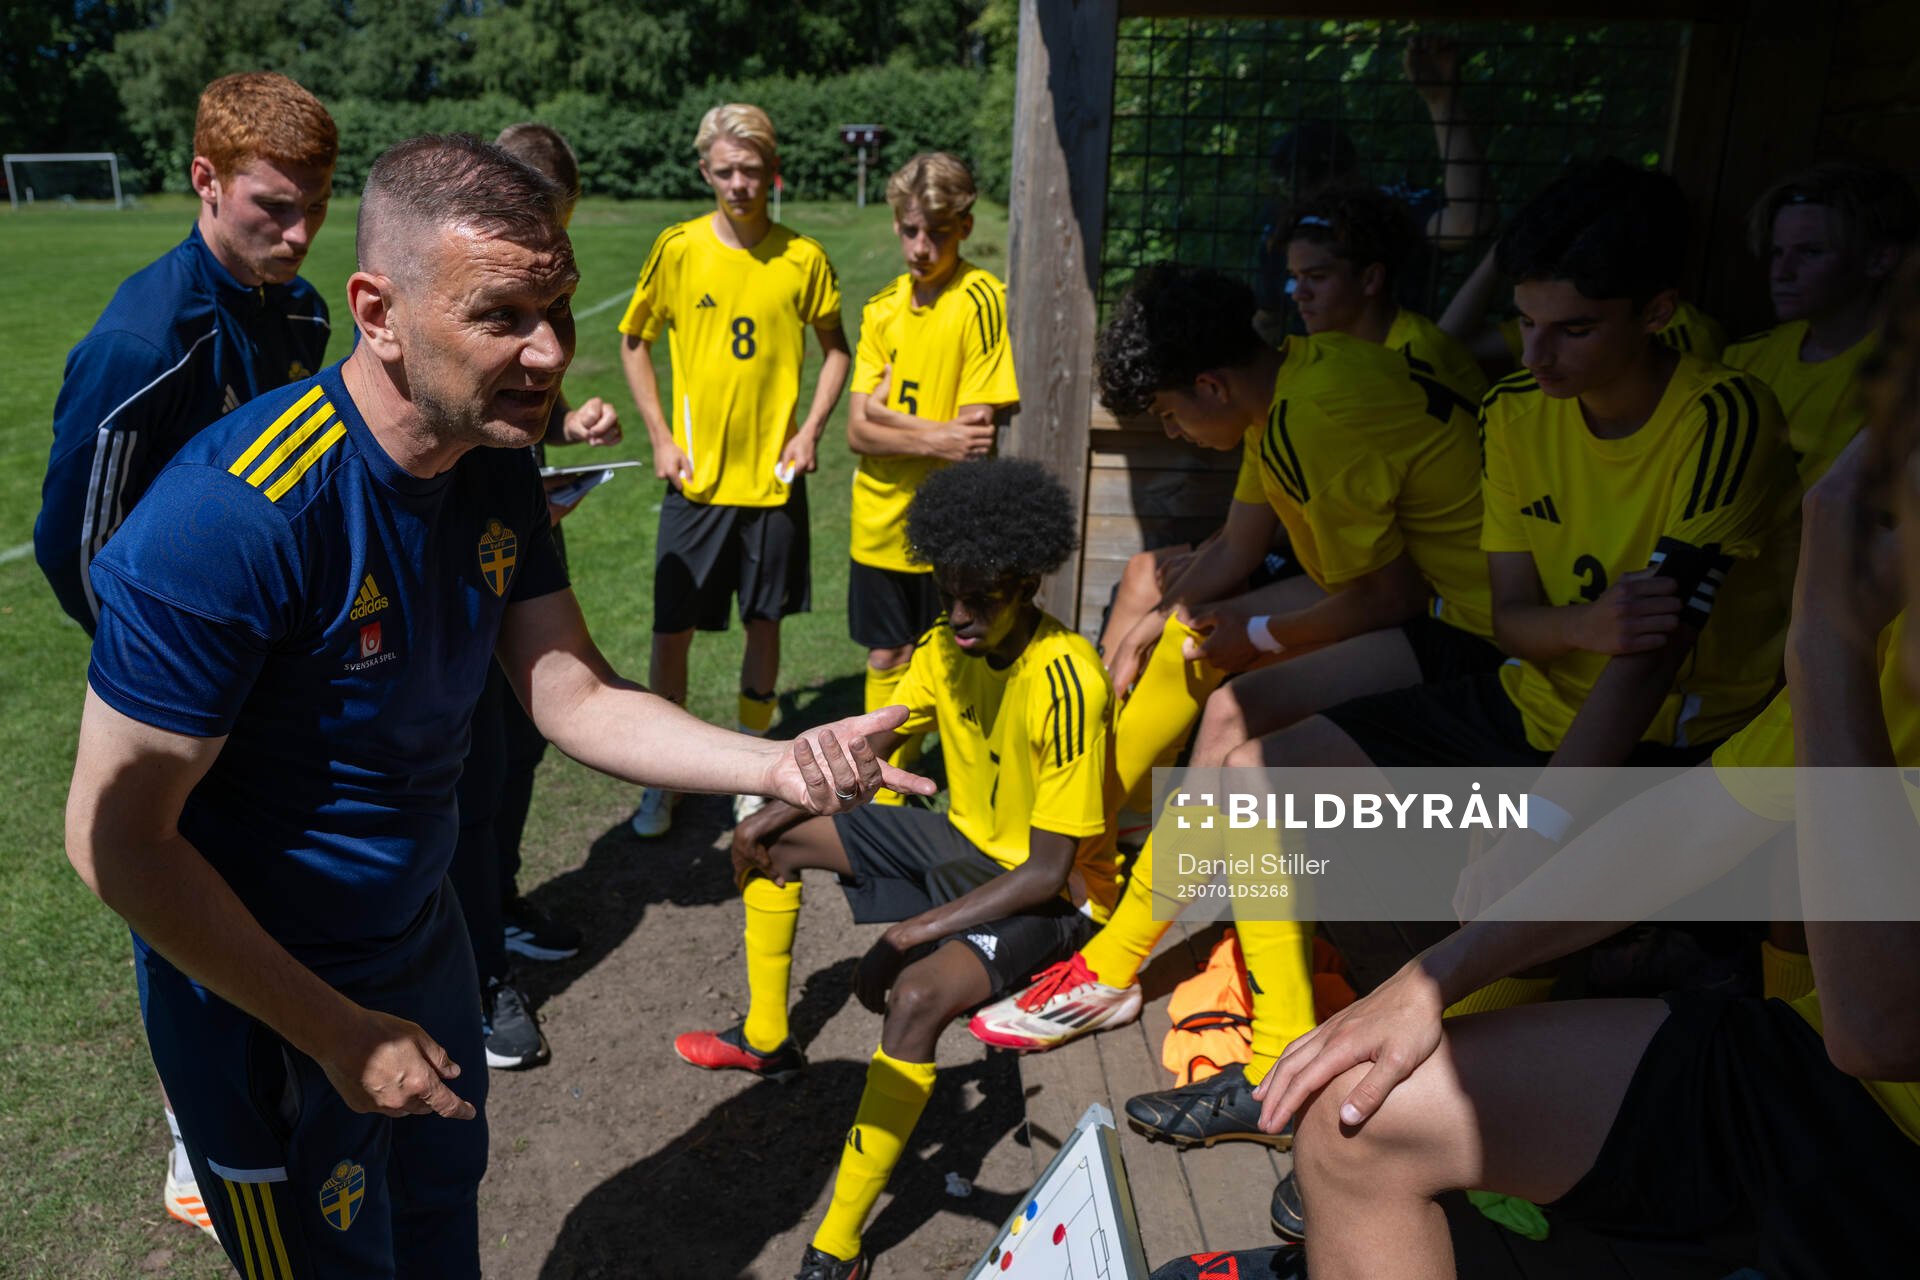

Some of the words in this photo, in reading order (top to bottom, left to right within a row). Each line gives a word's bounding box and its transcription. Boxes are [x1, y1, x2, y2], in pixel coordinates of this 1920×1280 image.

[731, 316, 757, 361] 8
[898, 379, 920, 416] 5
[349, 596, 389, 621] adidas
[343, 656, 379, 671] SVENSKA
[379, 651, 397, 663] SPEL
